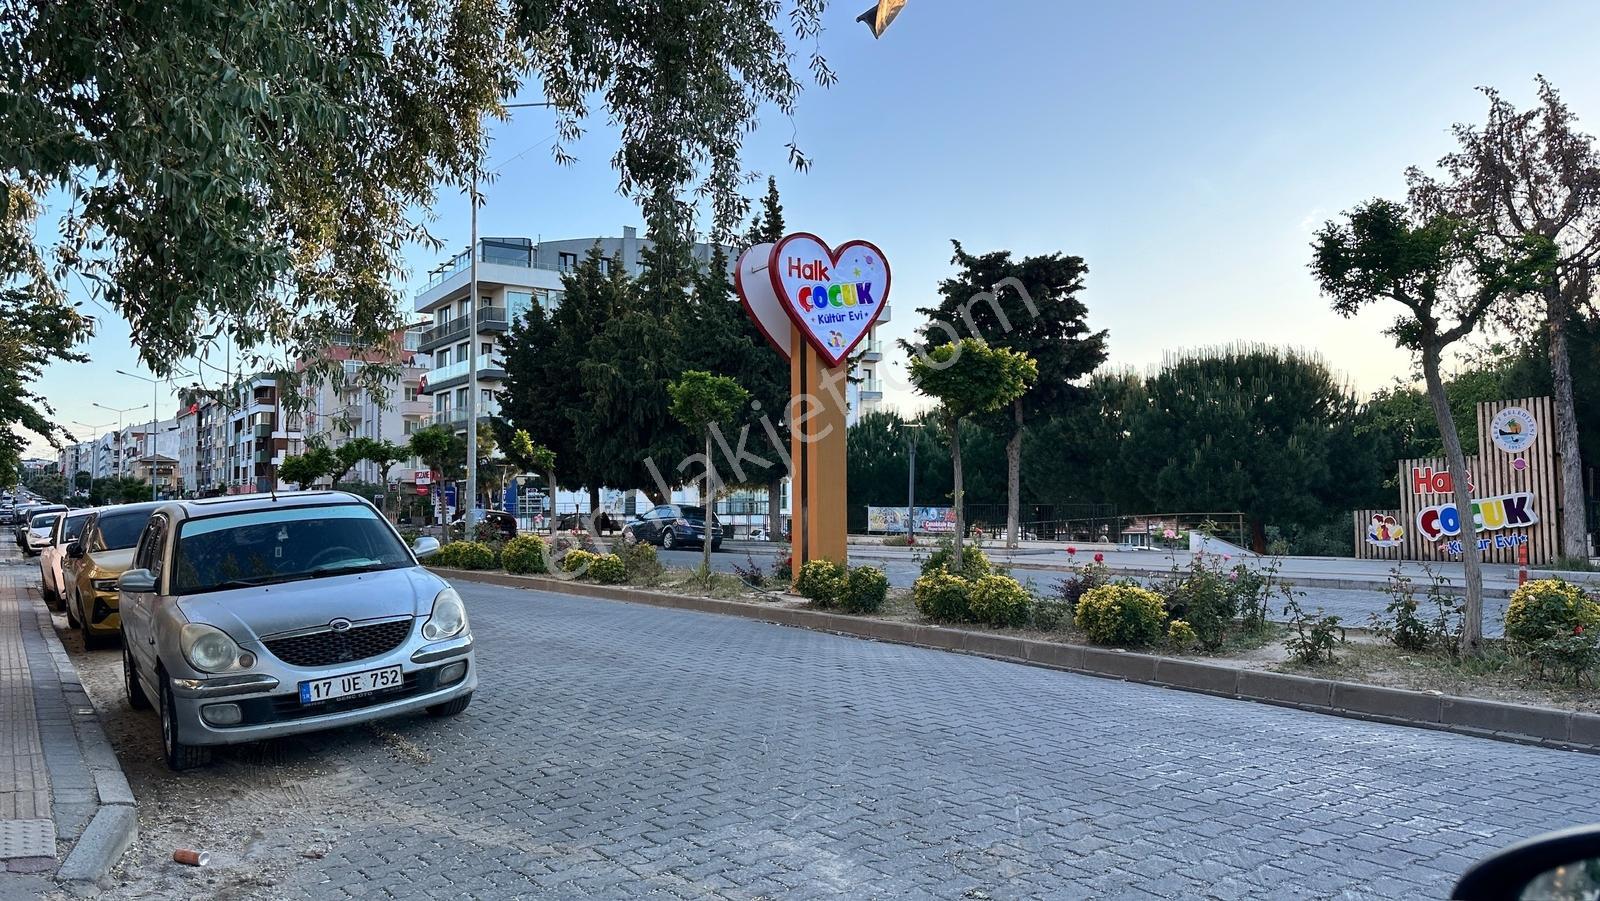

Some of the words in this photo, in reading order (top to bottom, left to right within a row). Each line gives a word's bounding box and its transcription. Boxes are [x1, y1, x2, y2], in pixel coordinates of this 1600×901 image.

[788, 256, 831, 282] Halk
[798, 282, 875, 313] ÇOCUK
[817, 312, 846, 325] Kültür
[849, 311, 864, 321] Evi
[1495, 532, 1519, 549] Evi
[313, 681, 332, 698] 17
[341, 676, 362, 693] UE
[370, 669, 399, 688] 752
